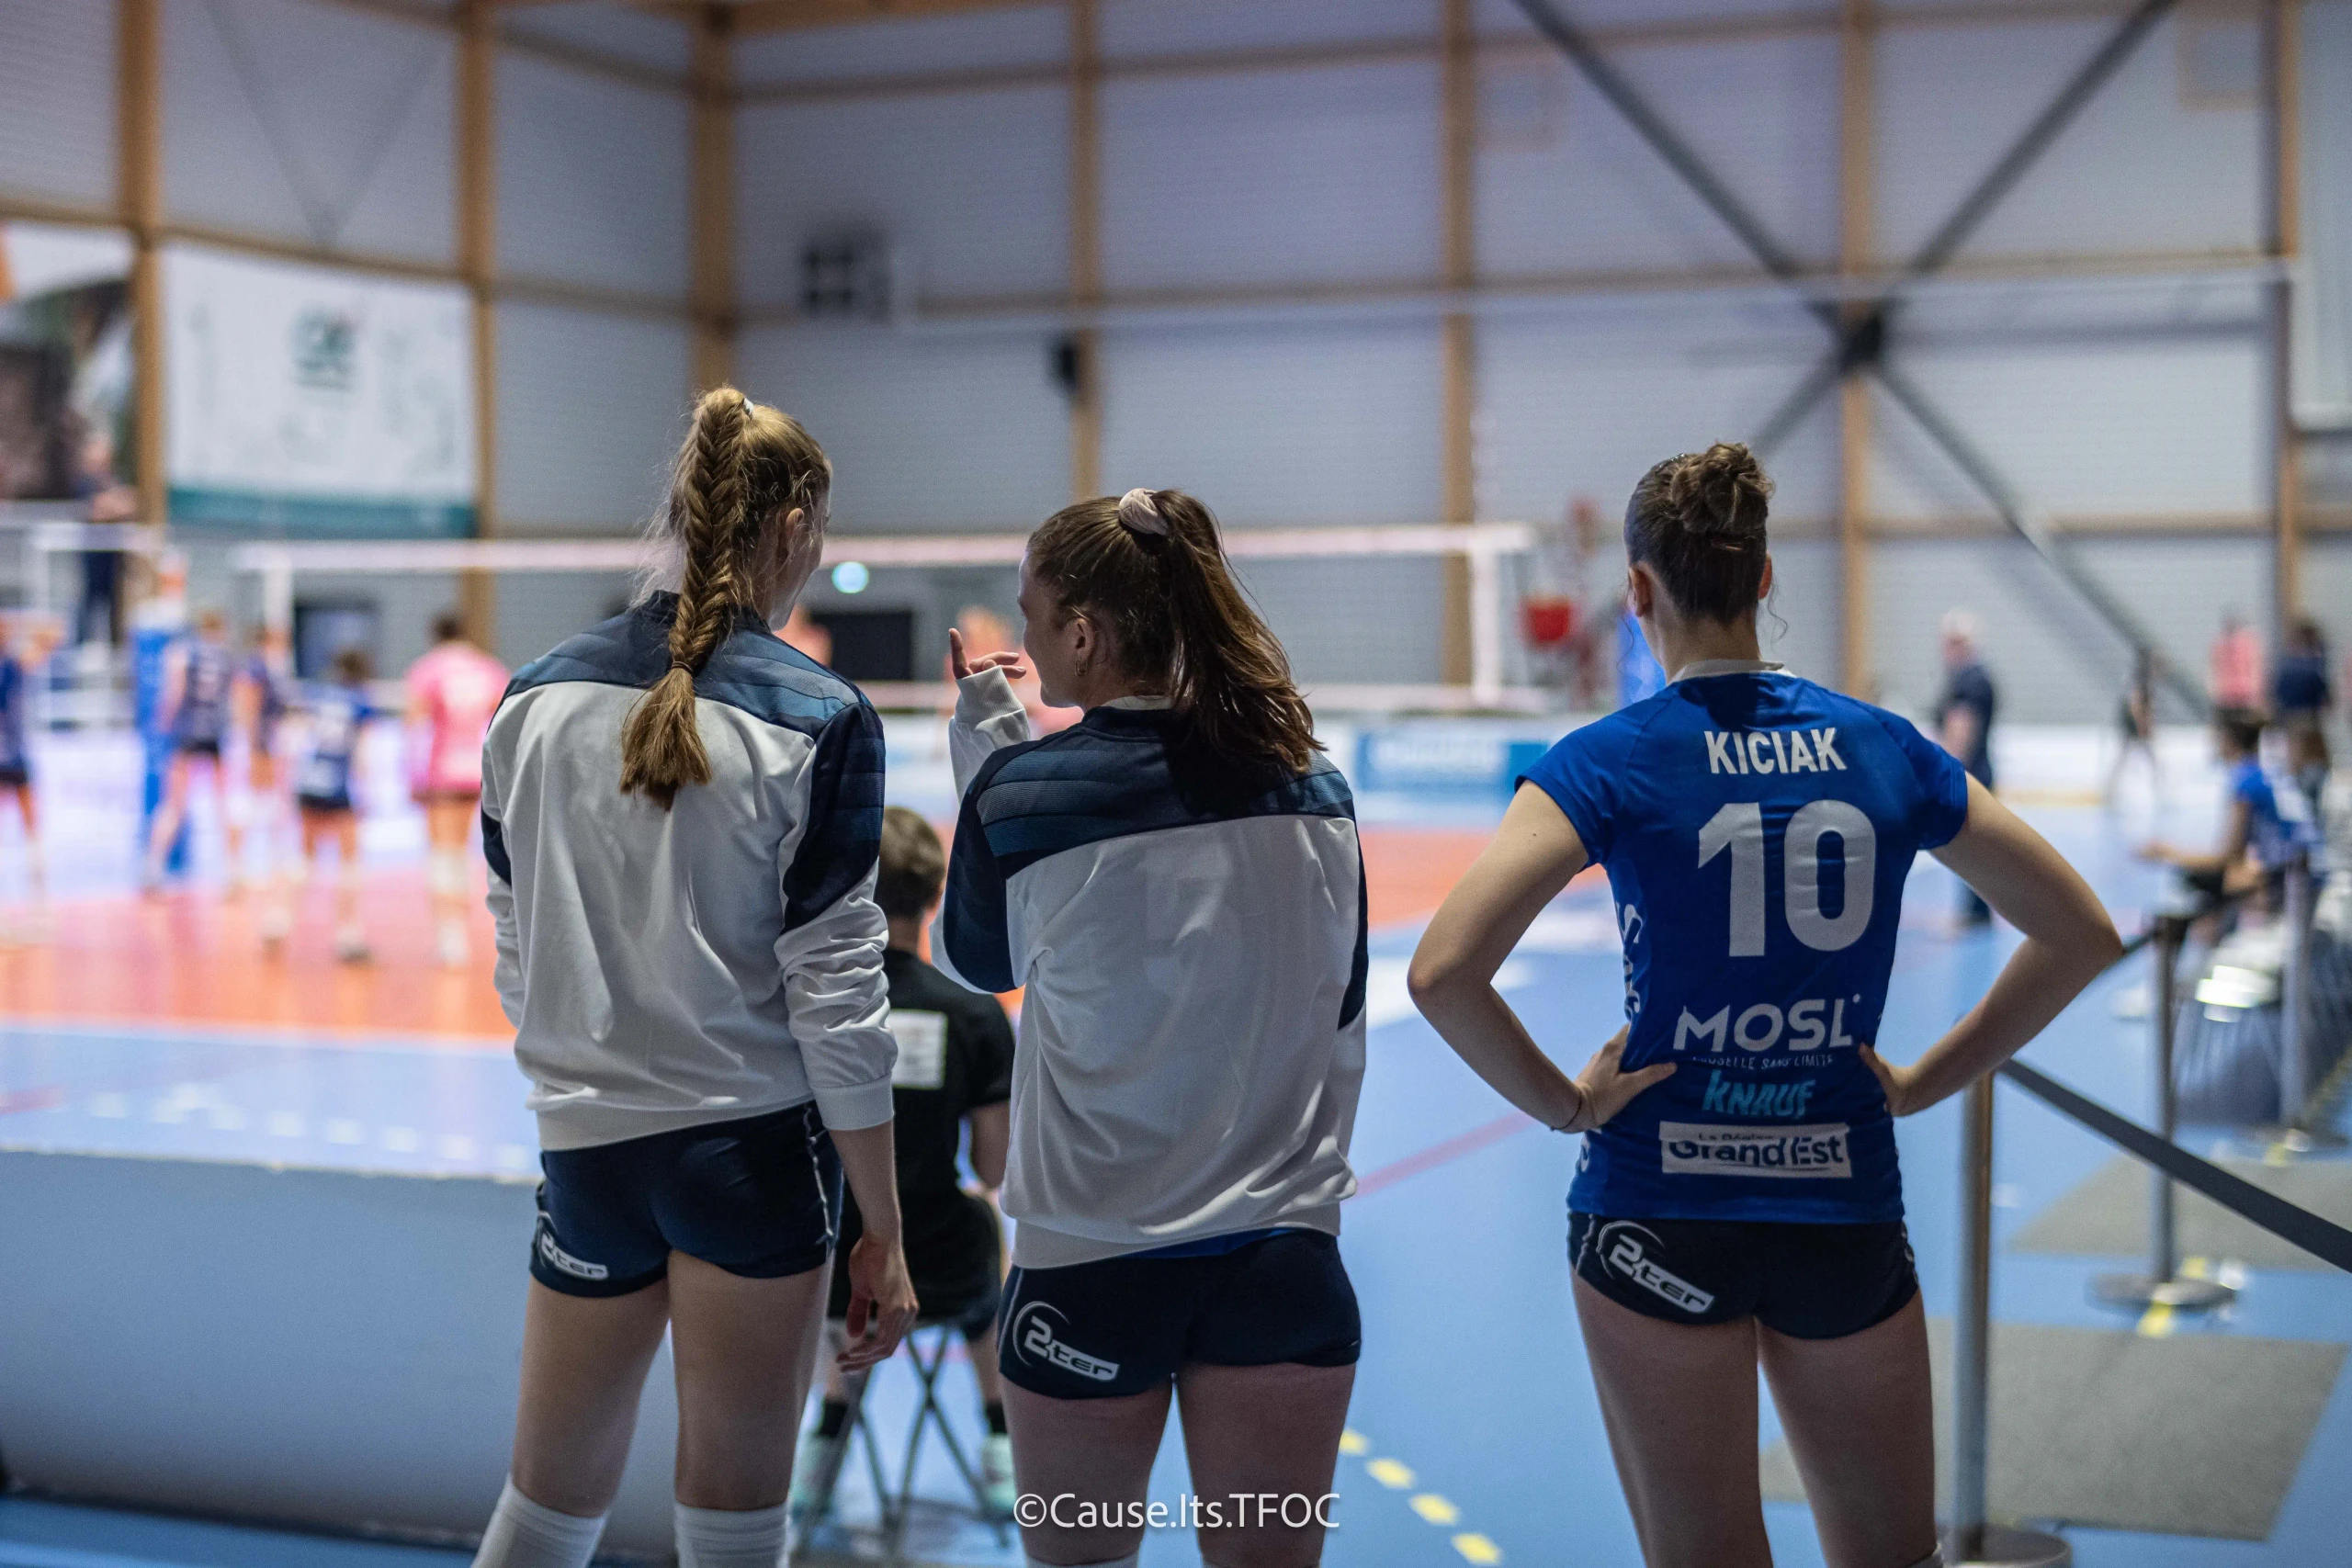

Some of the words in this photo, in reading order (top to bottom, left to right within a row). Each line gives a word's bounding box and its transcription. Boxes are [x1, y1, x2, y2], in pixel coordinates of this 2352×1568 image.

[1704, 728, 1847, 774] KICIAK
[1698, 799, 1877, 957] 10
[1702, 1069, 1816, 1118] KNAUF
[1608, 1234, 1715, 1314] 2ter
[1024, 1315, 1121, 1380] 2ter
